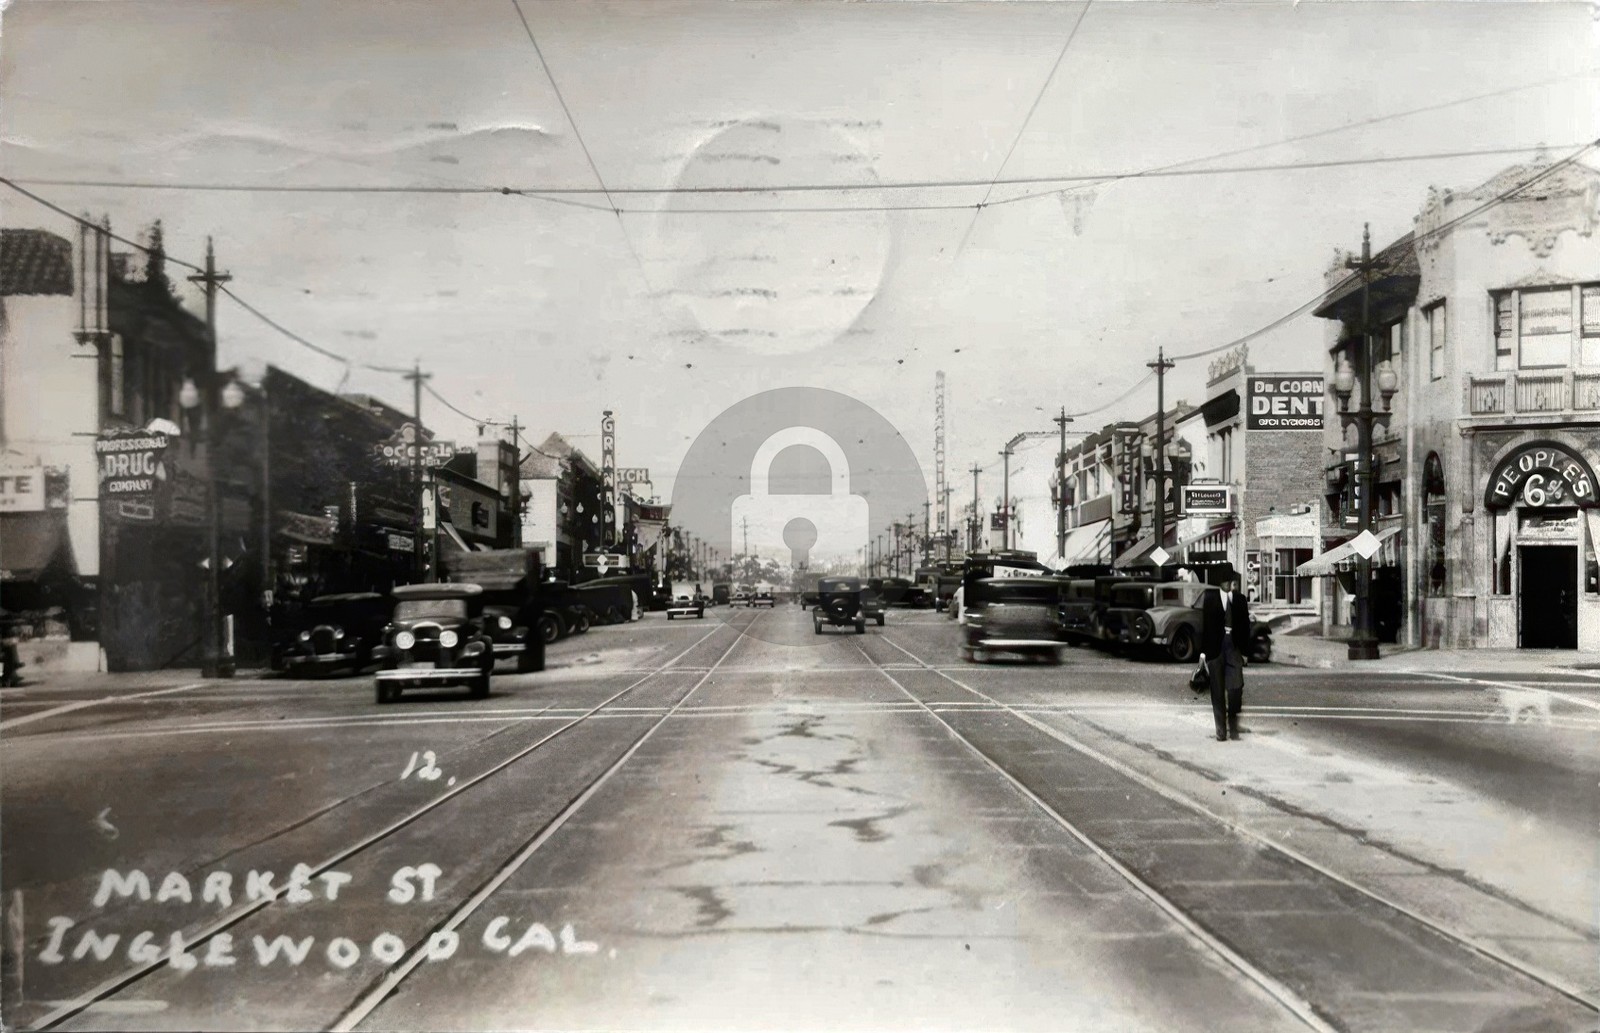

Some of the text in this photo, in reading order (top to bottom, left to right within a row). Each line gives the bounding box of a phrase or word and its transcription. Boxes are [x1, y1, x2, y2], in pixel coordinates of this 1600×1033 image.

[1252, 396, 1324, 415] DENT
[105, 451, 154, 477] DRUG
[1495, 451, 1592, 498] PEOPLE'S
